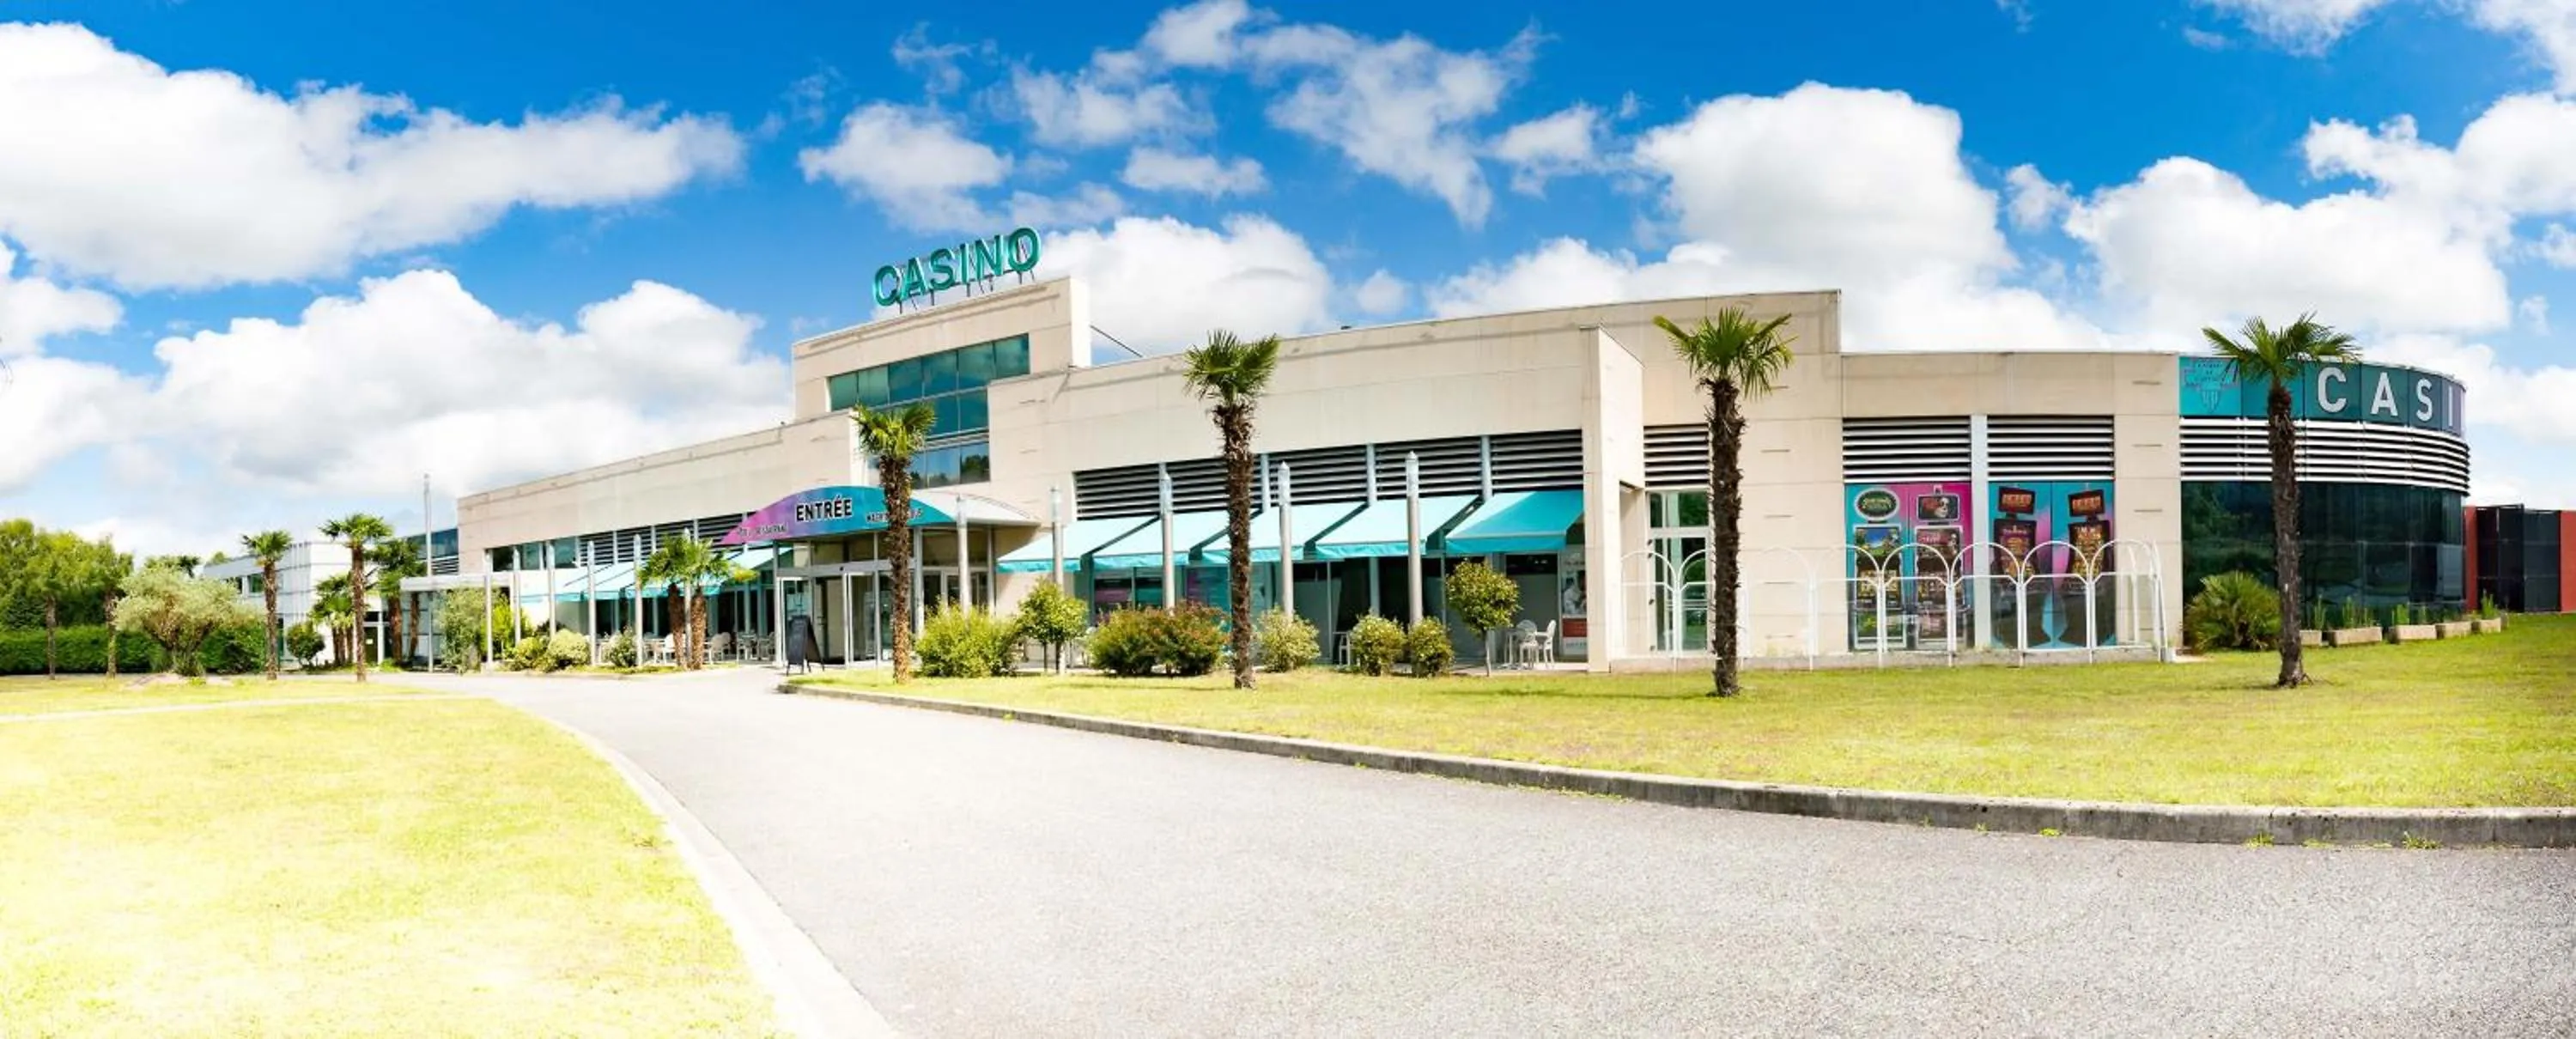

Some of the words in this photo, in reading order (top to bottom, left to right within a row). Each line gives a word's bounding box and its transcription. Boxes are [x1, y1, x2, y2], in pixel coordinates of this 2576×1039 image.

[873, 227, 1041, 307] CASINO
[2318, 367, 2453, 428] CASI
[795, 494, 853, 522] ENTRÉE
